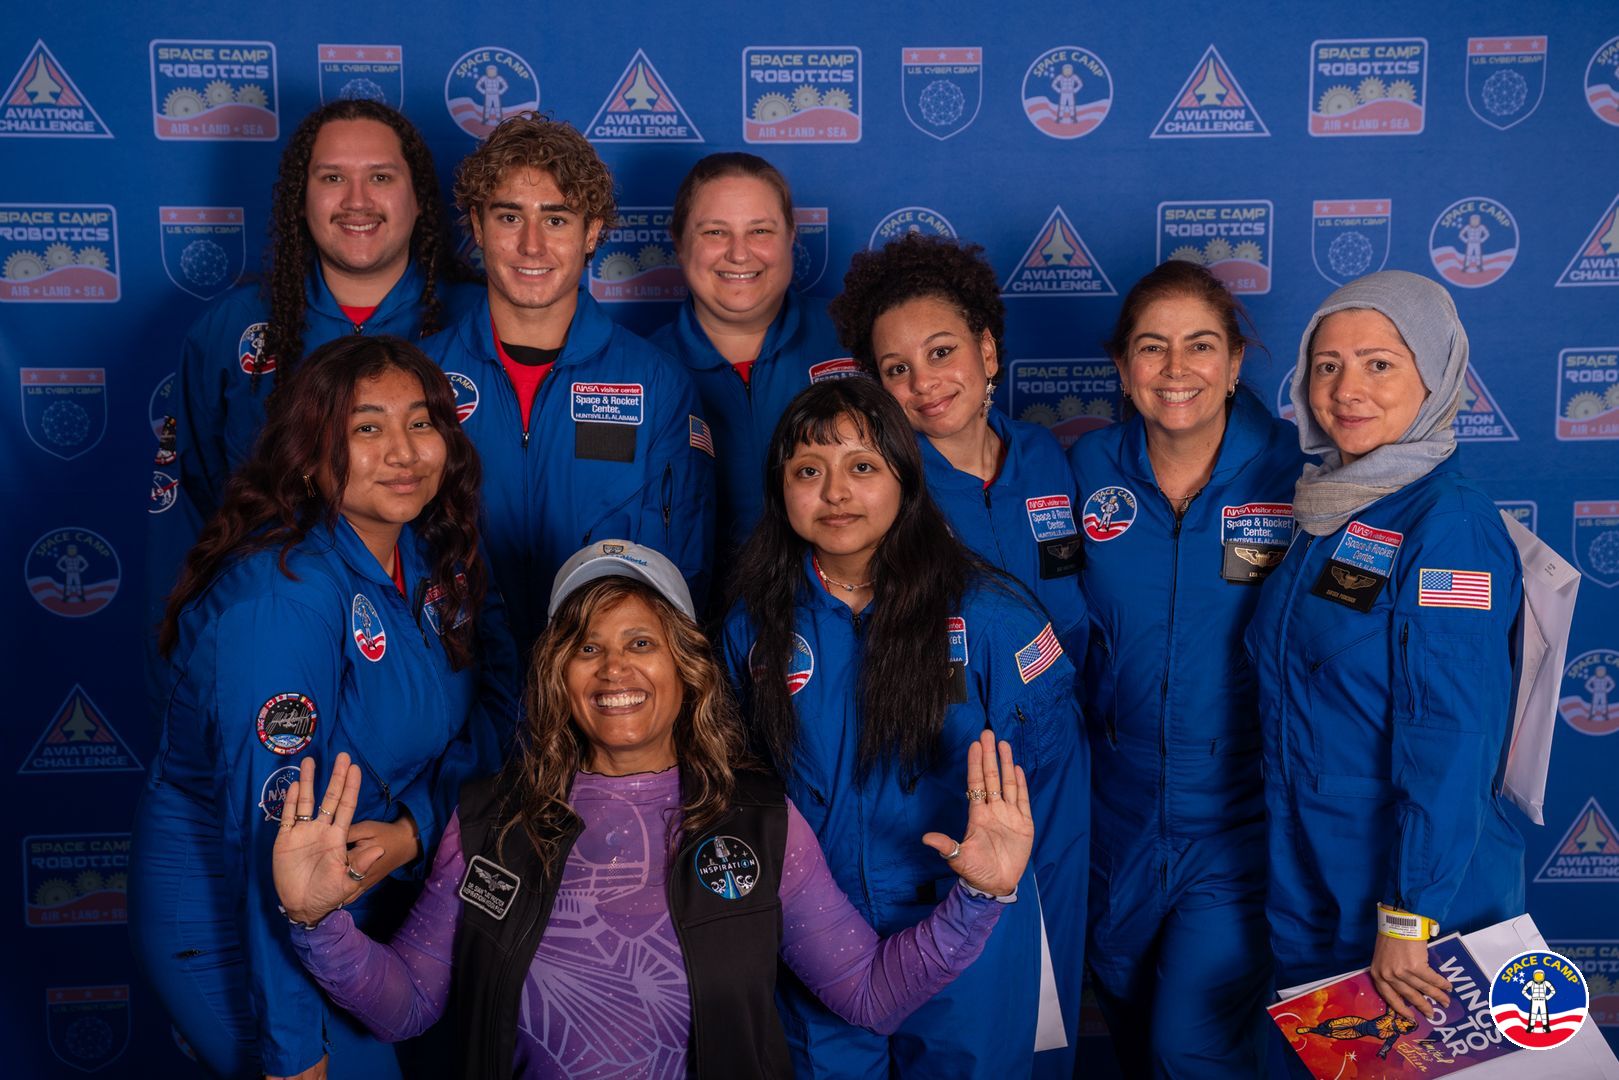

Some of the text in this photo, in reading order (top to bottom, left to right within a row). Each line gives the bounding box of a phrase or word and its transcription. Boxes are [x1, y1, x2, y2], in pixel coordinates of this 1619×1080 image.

[158, 48, 269, 63] SPACE CAMP
[1319, 46, 1420, 61] SPACE CAMP
[1597, 42, 1619, 65] SPA
[456, 52, 529, 79] SPACE CAMP
[750, 54, 854, 68] SPACE CAMP
[1033, 51, 1105, 78] SPACE CAMP
[158, 63, 269, 79] ROBOTICS
[325, 64, 340, 72] U.S.
[924, 66, 952, 74] CYBER
[1318, 61, 1420, 76] ROBOTICS
[750, 69, 854, 83] ROBOTICS
[5, 108, 84, 119] AVIATION
[604, 114, 677, 125] AVIATION
[1174, 110, 1245, 121] AVIATION
[0, 120, 95, 132] CHALLENGE
[170, 124, 264, 135] AIR LAND SEA
[1164, 120, 1254, 132] CHALLENGE
[1323, 118, 1409, 131] AIR LAND SEA
[594, 126, 687, 137] CHALLENGE
[758, 127, 847, 137] AIR LAND SEA
[0, 212, 109, 226] SPACE CAMP
[616, 215, 674, 227] ACE CA
[1165, 208, 1266, 222] SPACE CAMP
[1441, 202, 1510, 228] SPACE CAMP
[880, 212, 950, 238] SPACE CAMP
[1165, 223, 1265, 237] ROBOTICS
[0, 227, 110, 242] ROBOTICS
[606, 229, 674, 243] OBOTI
[1579, 258, 1619, 269] AVIAT
[1022, 269, 1092, 281] AVIATION
[1569, 270, 1619, 281] CHALL
[1012, 280, 1102, 292] CHALLENGE
[1237, 278, 1257, 289] SEA
[11, 286, 105, 297] AIR LAND SEA
[604, 286, 688, 296] AIR LAND SE
[1566, 355, 1617, 367] SPACE
[1017, 366, 1117, 379] SPACE CAMP
[1566, 369, 1618, 383] ROBO
[451, 375, 474, 391] CAMP
[576, 385, 599, 393] NASA
[1017, 380, 1117, 394] ROBOTICS
[576, 395, 639, 406] Space & Rocket
[1453, 414, 1495, 425] ATION
[1456, 425, 1503, 436] LENGE
[1571, 424, 1587, 435] AIR
[1118, 490, 1135, 509] CAMP
[1227, 507, 1251, 516] NASA
[1227, 517, 1292, 530] Space & Rocket
[1351, 525, 1373, 537] NASA
[36, 532, 110, 557] SPACE CAMP
[1345, 537, 1365, 550] Space
[1371, 543, 1394, 558] Rocket
[1568, 655, 1619, 679] SPACE CA
[42, 745, 117, 757] AVIATION
[32, 756, 128, 768] CHALLENGE
[31, 841, 85, 854] SPACE
[32, 854, 129, 869] ROBOTIC
[1547, 867, 1619, 877] CHALLENG
[1599, 946, 1619, 958] CA
[1457, 1016, 1489, 1051] TO
